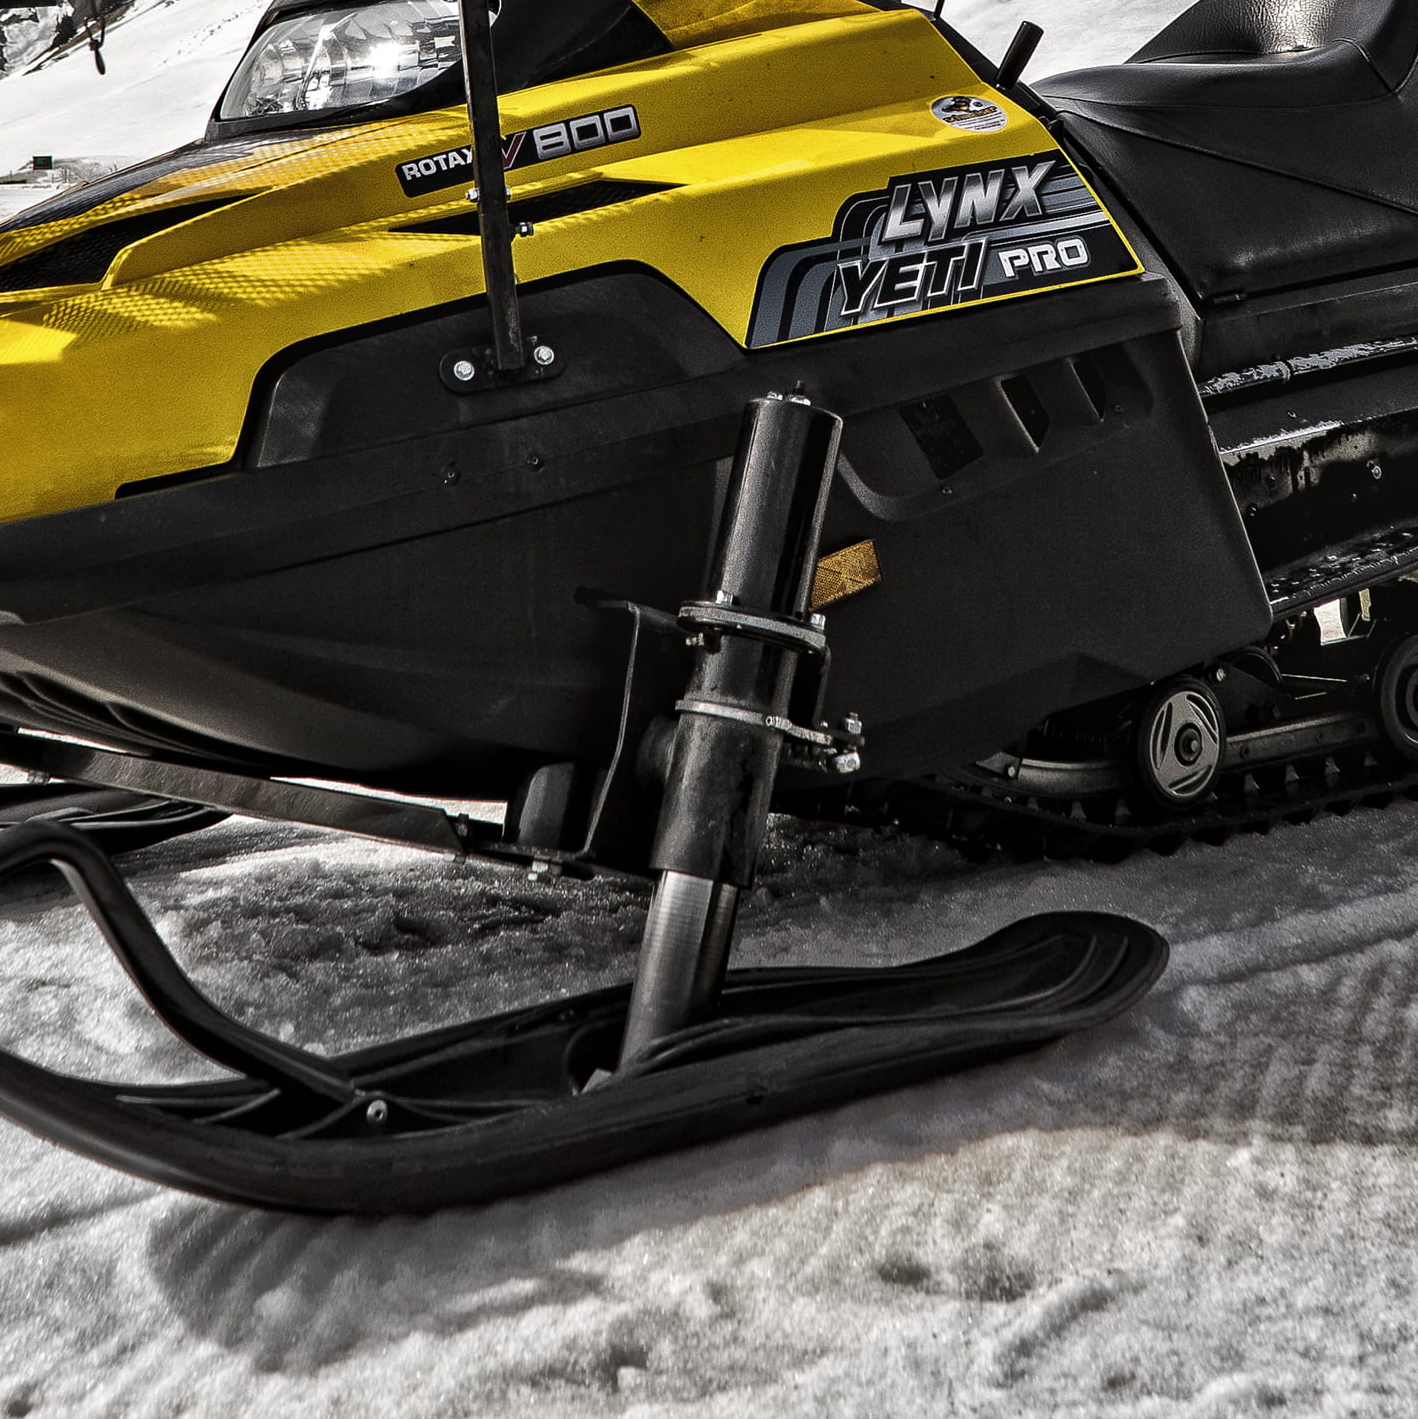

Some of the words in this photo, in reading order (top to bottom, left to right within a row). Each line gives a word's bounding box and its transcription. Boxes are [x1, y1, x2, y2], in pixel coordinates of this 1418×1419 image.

[882, 160, 1056, 242] LYNX
[837, 237, 988, 316] YETI
[998, 238, 1089, 278] PRO
